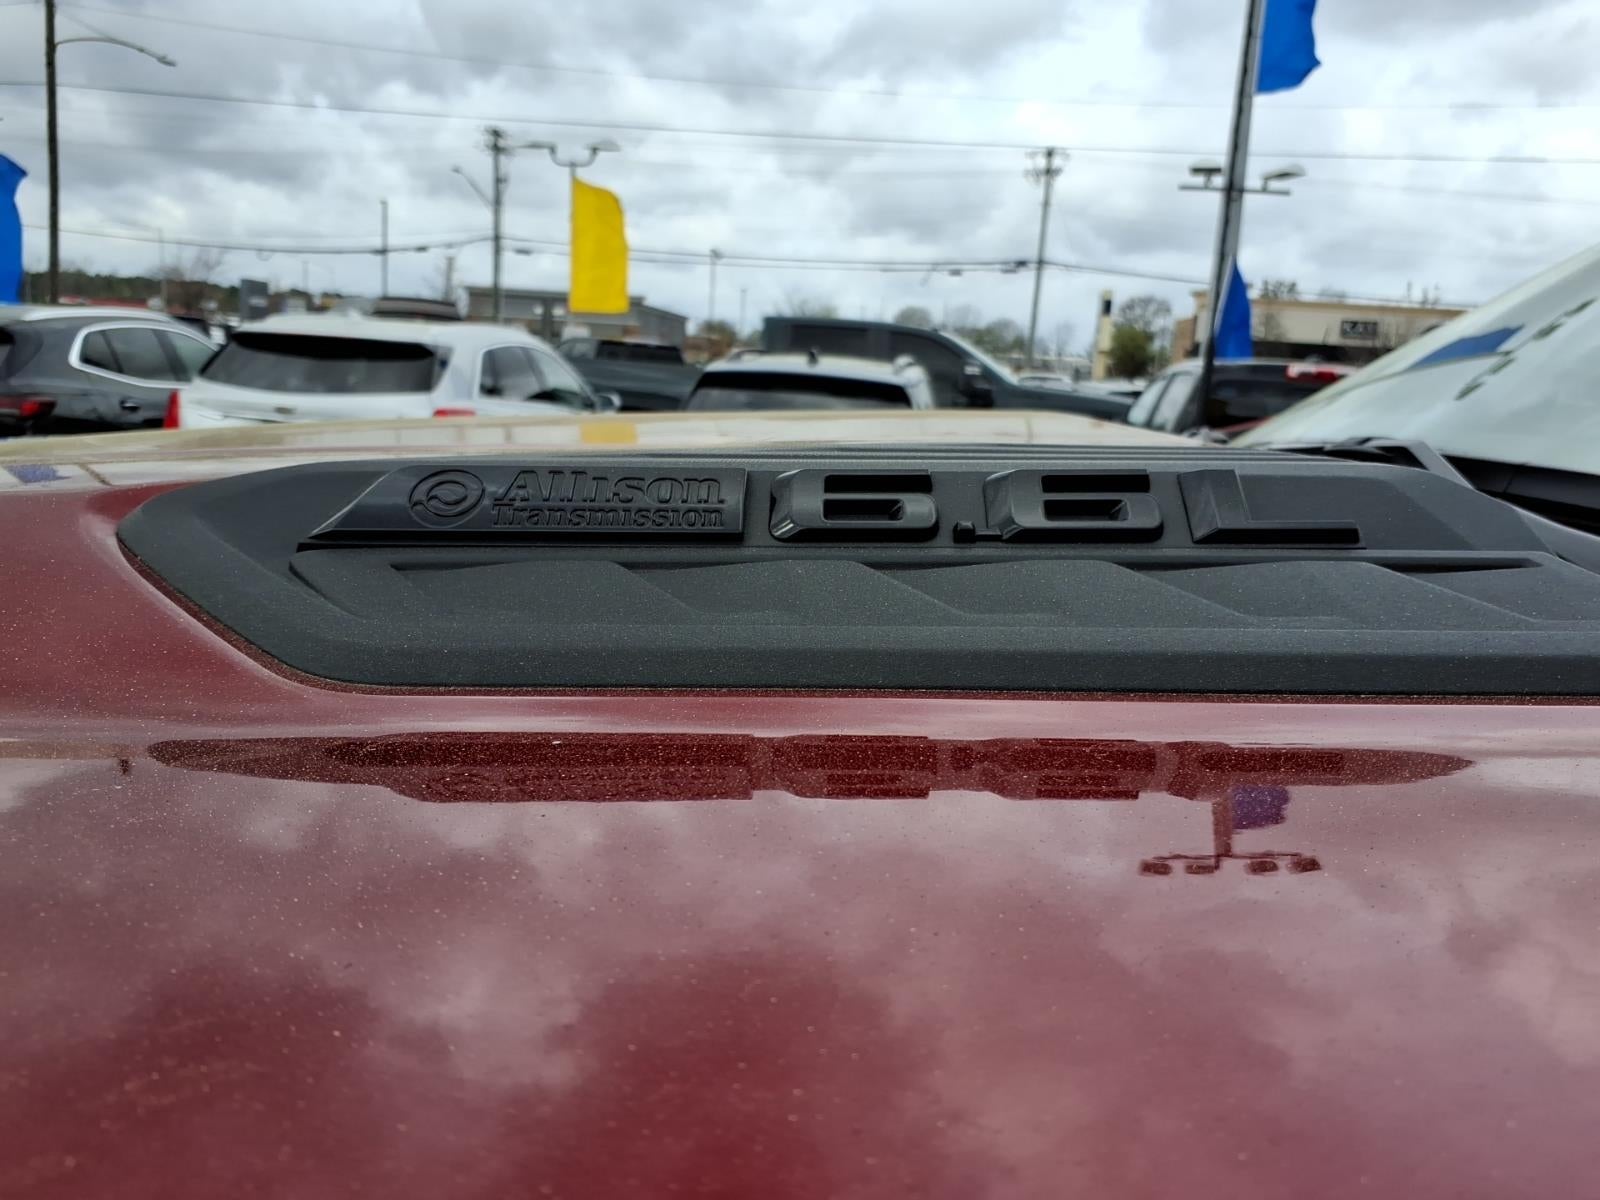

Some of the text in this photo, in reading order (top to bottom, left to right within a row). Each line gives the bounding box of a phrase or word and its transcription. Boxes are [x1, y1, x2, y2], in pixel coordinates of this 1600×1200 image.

[494, 470, 726, 505] Allison
[492, 504, 725, 528] Transmission
[769, 469, 1362, 546] 6.6L
